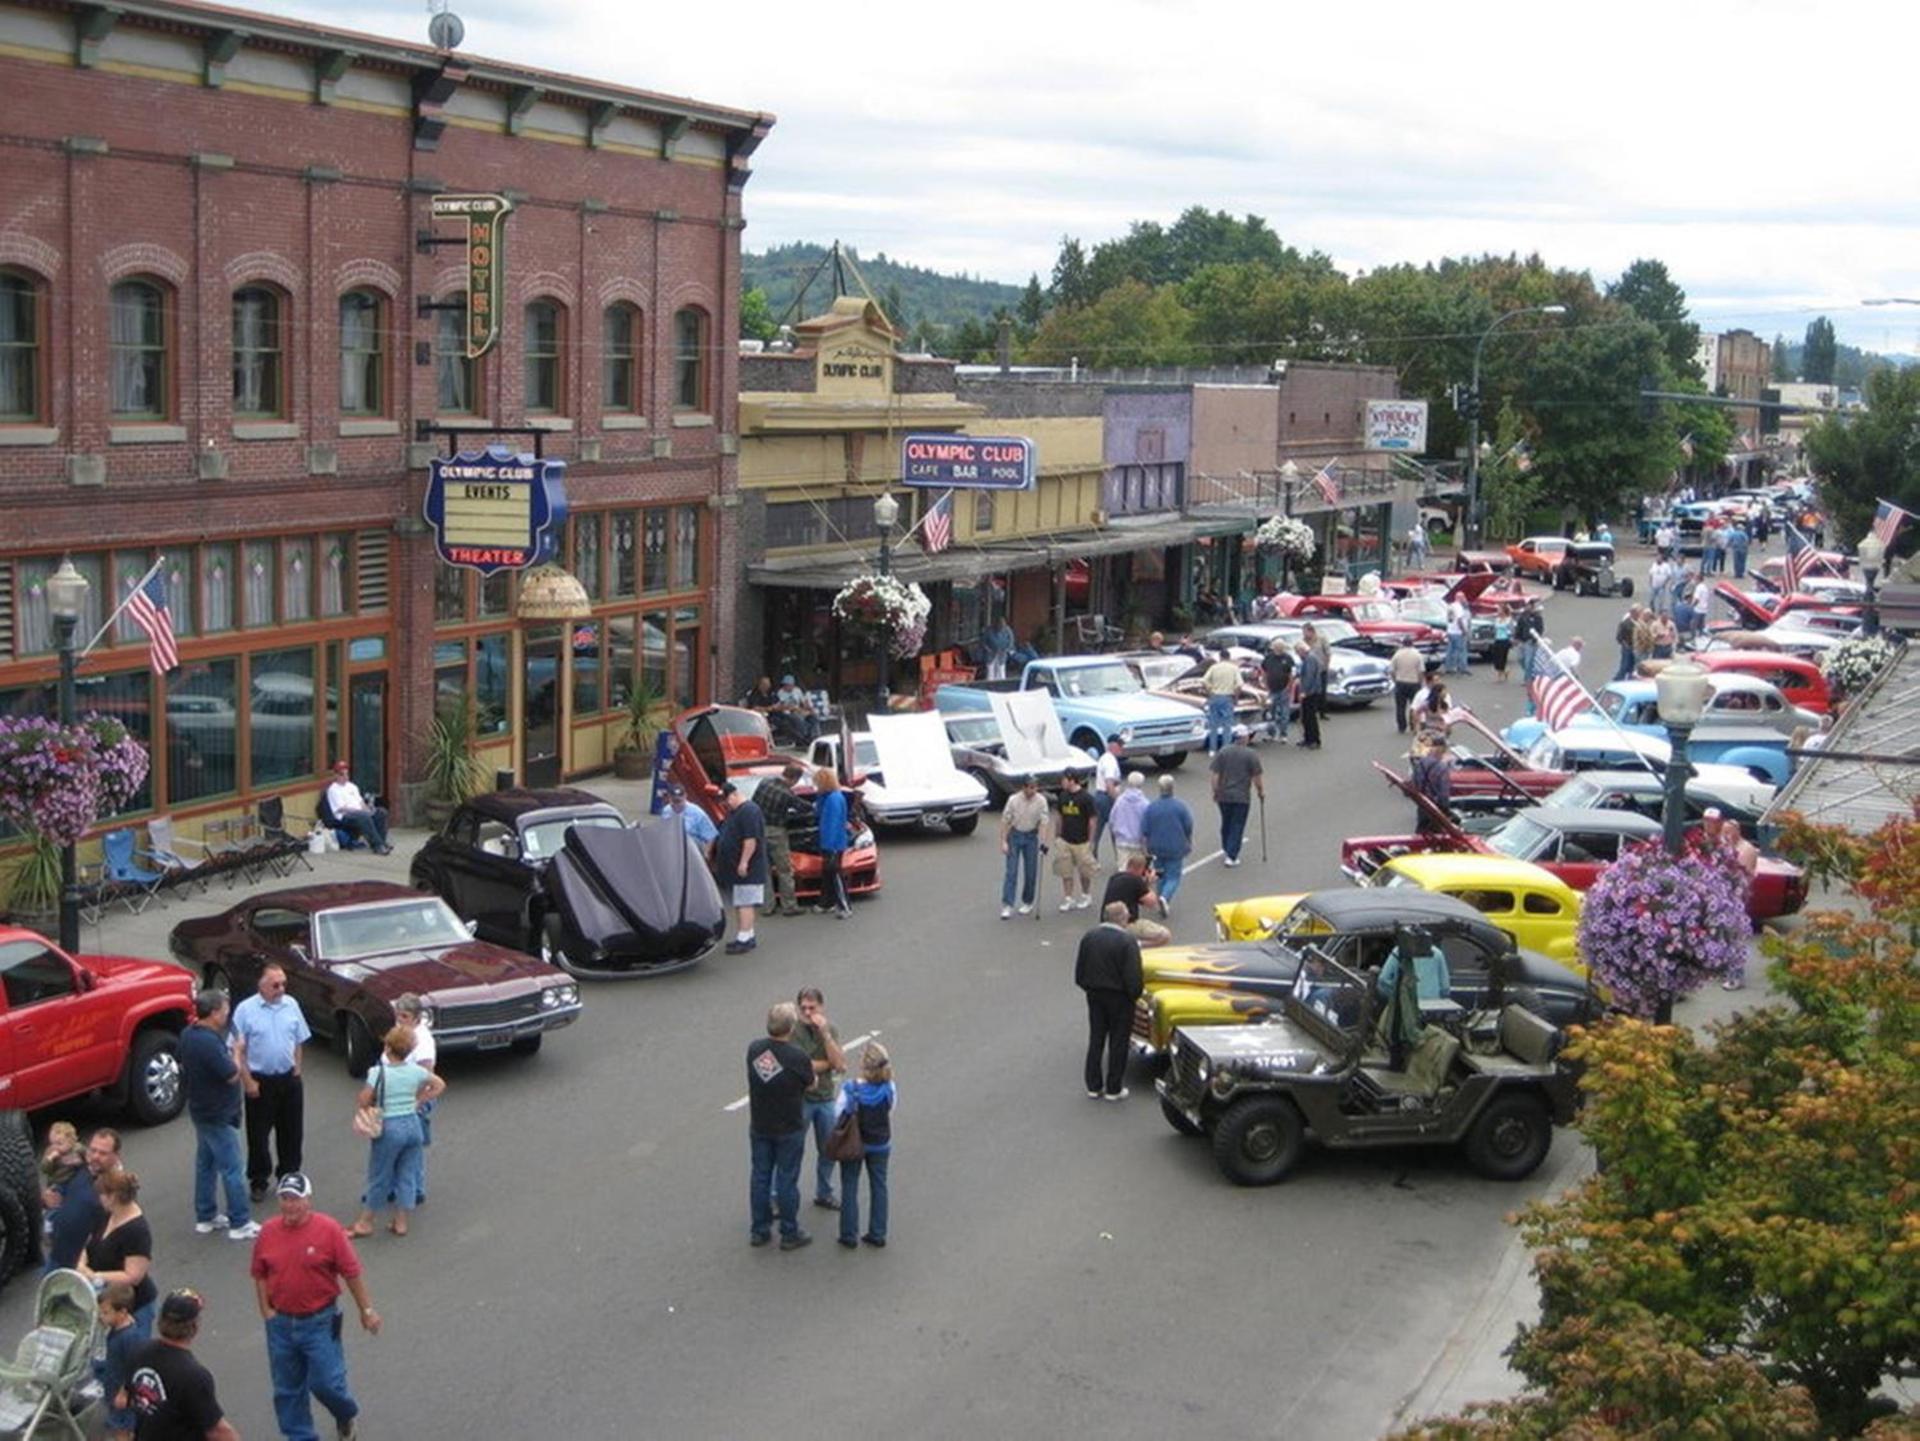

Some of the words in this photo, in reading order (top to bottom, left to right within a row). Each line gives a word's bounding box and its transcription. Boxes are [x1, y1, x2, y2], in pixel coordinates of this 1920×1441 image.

[433, 201, 471, 212] OLYMPIC
[472, 201, 497, 212] CLUB
[472, 222, 490, 337] HOTEL
[823, 363, 857, 378] OLYMPIC
[859, 365, 883, 378] CLUB
[908, 443, 976, 460] OLYMPIC
[981, 446, 1024, 463] CLUB
[439, 466, 496, 479] OLYMPIC
[498, 468, 535, 479] CLUB
[911, 464, 938, 476] CAFE
[952, 465, 978, 478] BAR
[991, 467, 1019, 479] POOL
[465, 484, 511, 500] EVENTS
[450, 548, 525, 564] THEATER
